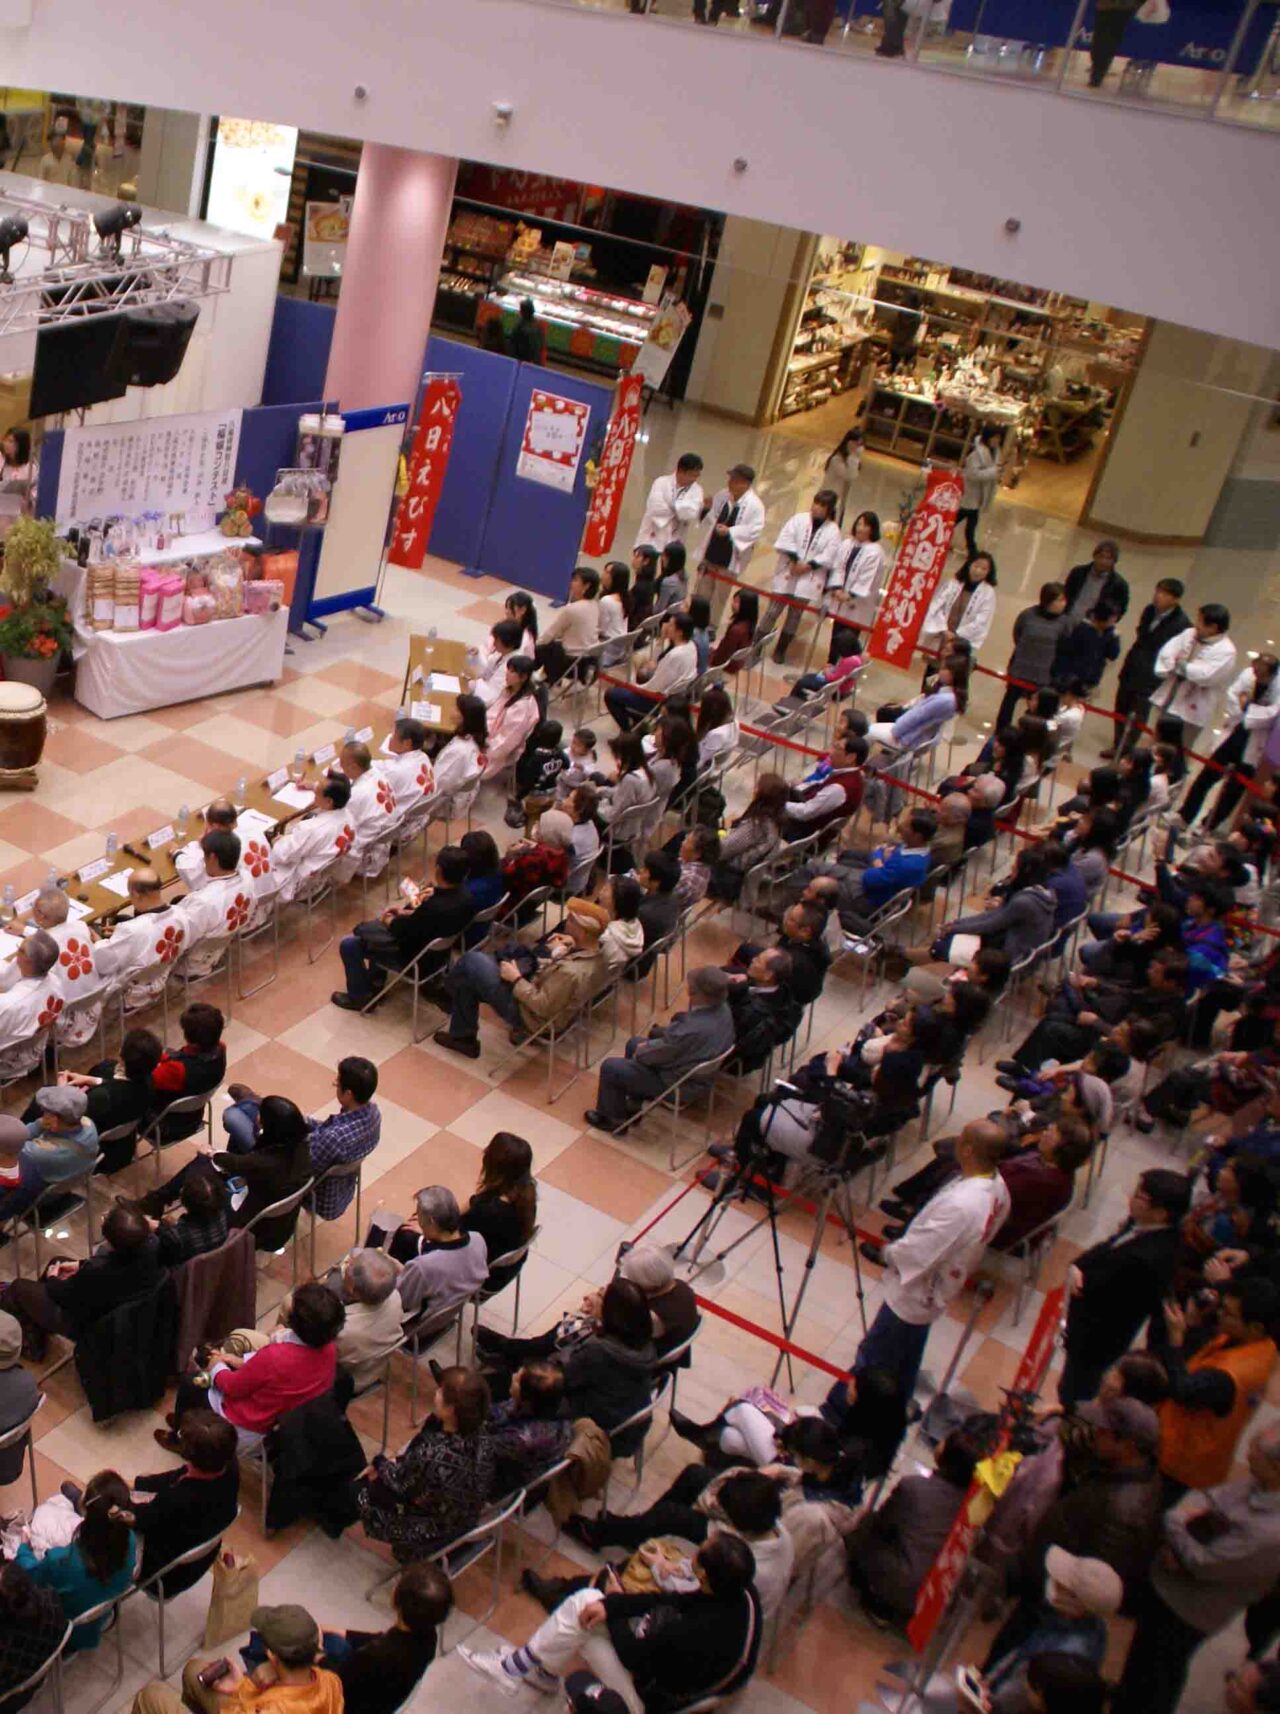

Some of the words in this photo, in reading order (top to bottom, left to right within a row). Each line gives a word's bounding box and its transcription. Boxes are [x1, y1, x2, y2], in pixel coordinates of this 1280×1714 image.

[401, 397, 451, 553] 八日えびす
